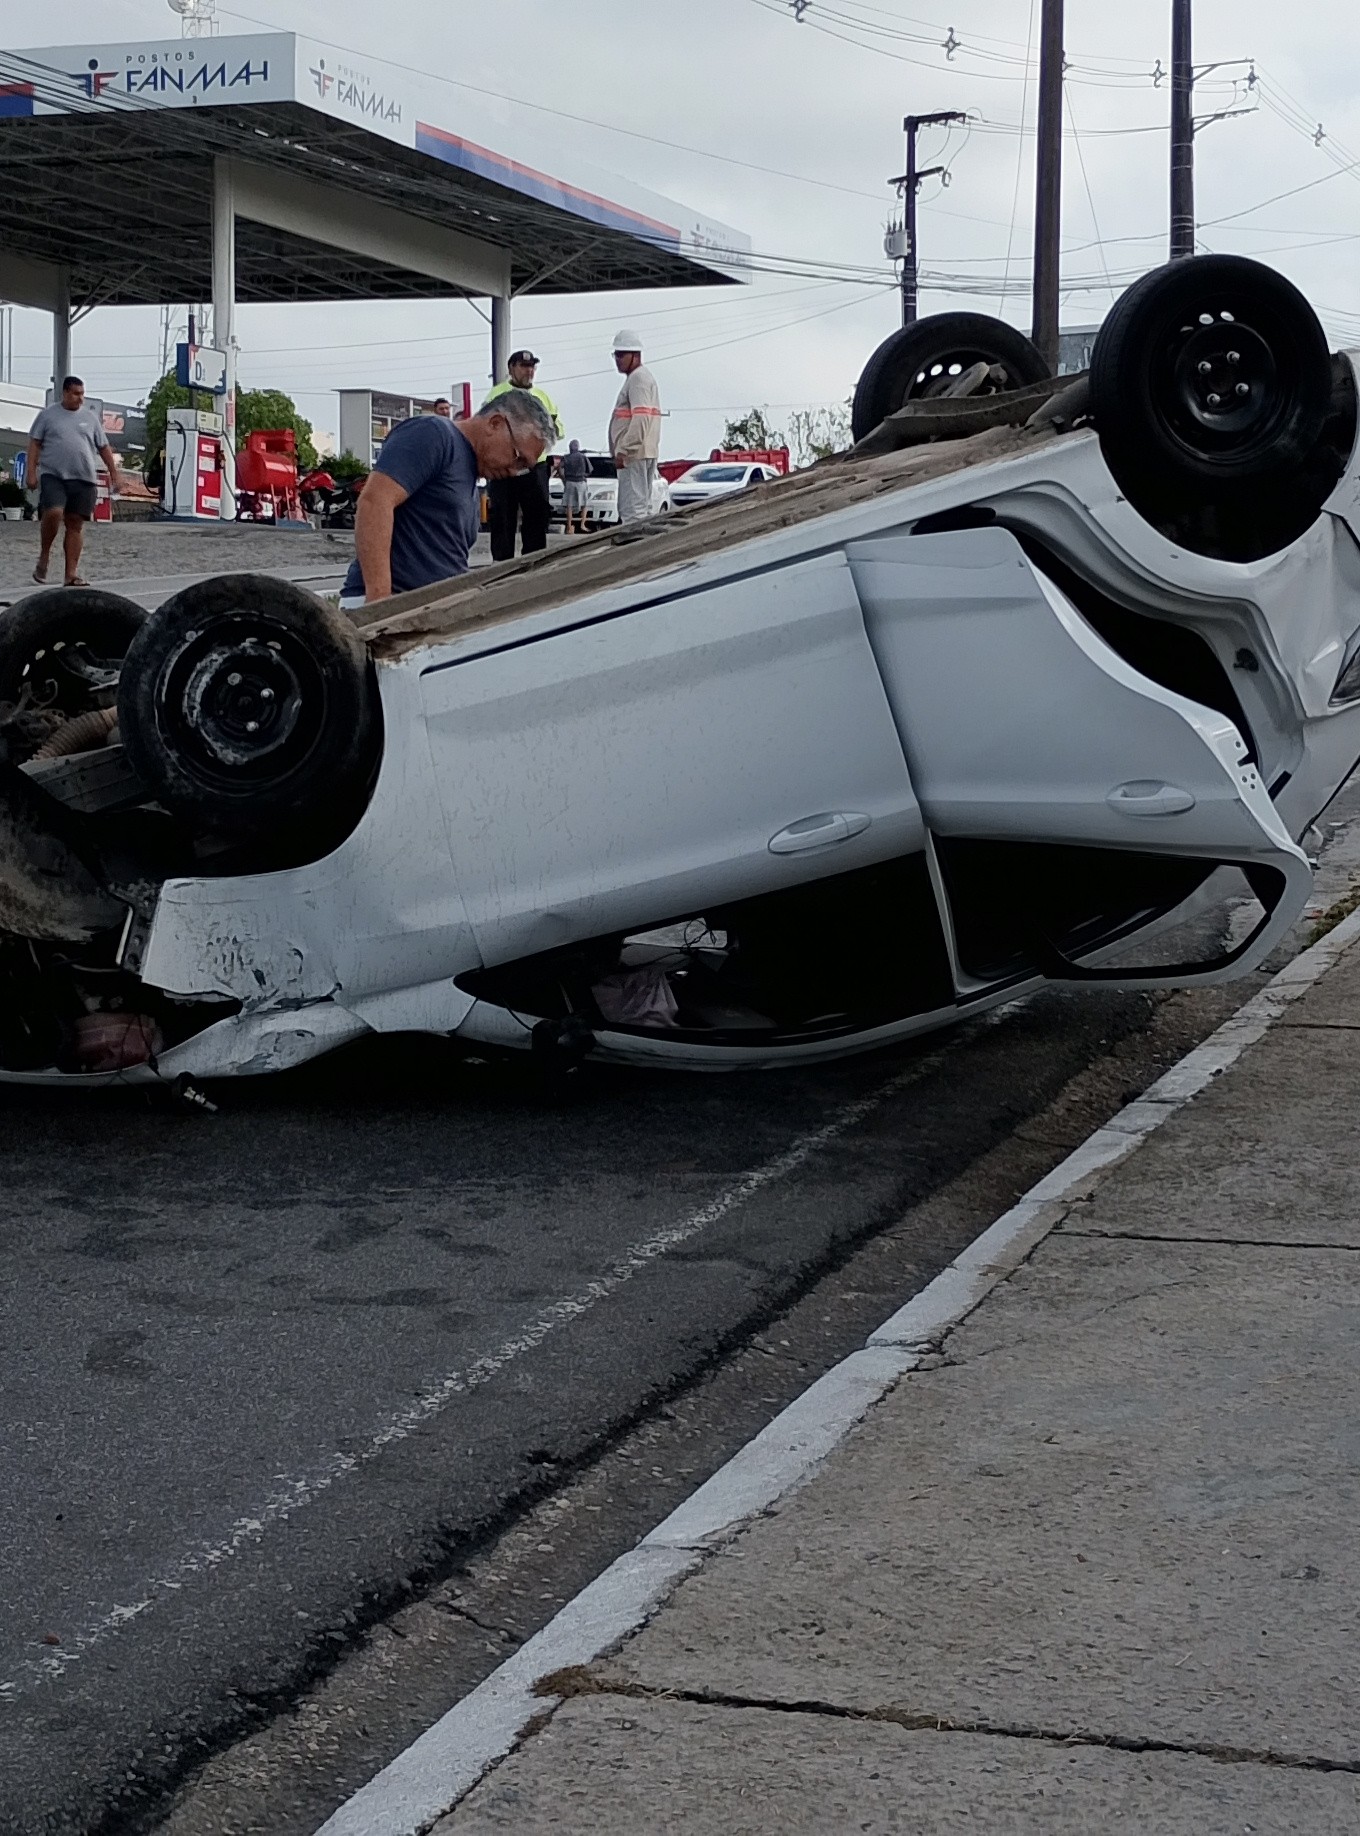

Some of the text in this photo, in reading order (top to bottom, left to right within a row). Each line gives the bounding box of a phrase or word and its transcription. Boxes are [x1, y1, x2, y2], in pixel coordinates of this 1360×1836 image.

[126, 52, 195, 64] POSTOS
[126, 60, 269, 94] FANMAH
[337, 82, 403, 124] FANMAH
